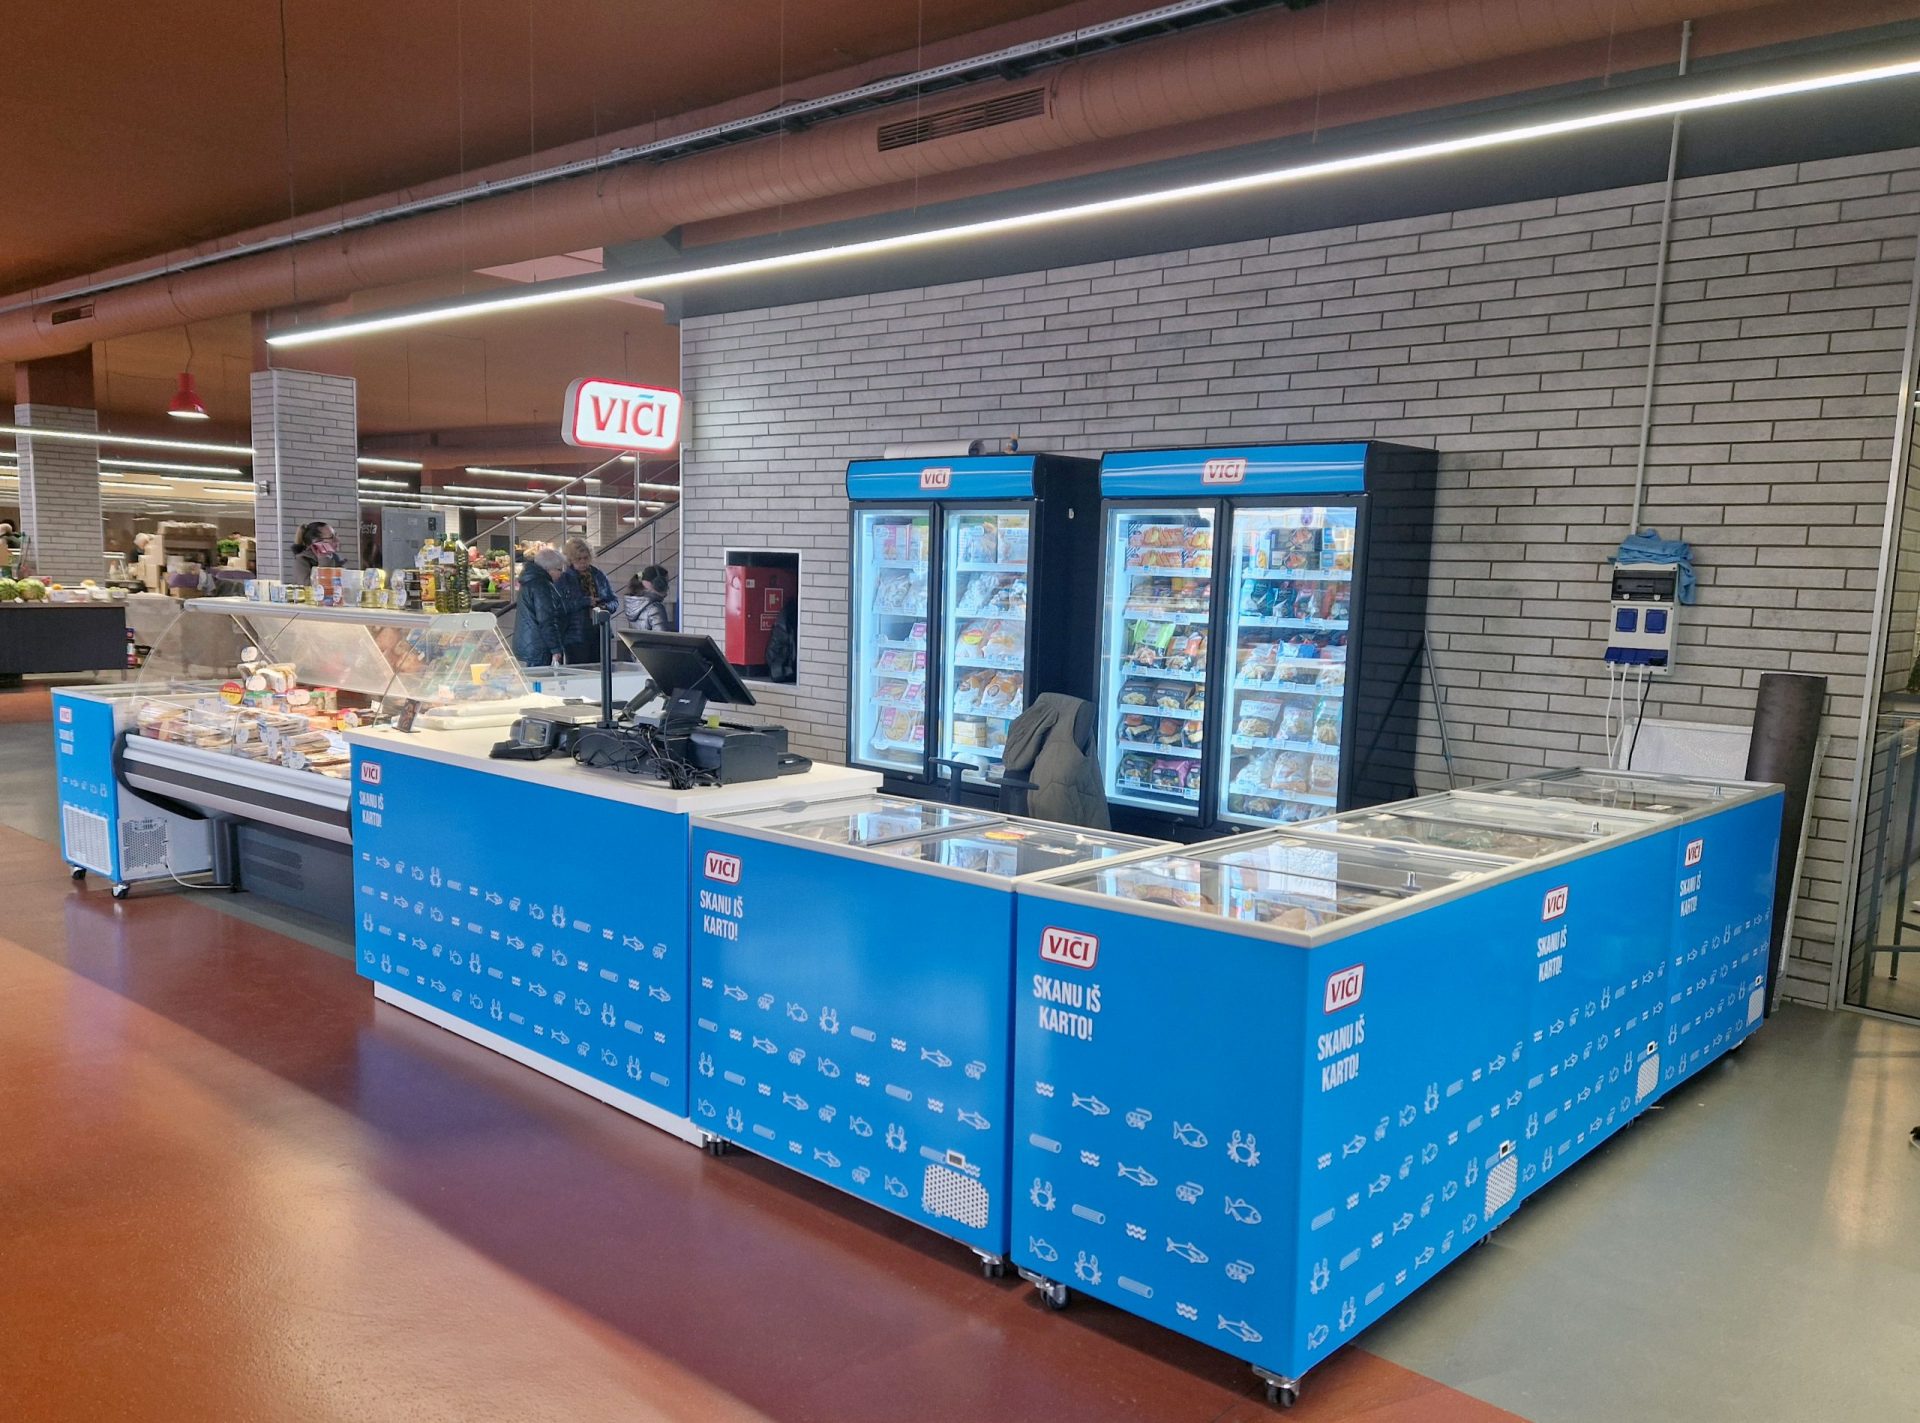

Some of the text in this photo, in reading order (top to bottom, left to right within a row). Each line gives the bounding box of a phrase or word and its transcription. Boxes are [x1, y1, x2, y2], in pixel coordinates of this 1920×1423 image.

[700, 889, 743, 918] SKANU IŠ
[704, 914, 737, 941] KARTO!
[1537, 924, 1568, 958] SKANU IŠ
[1539, 955, 1563, 983] KARTO!
[1033, 974, 1101, 1013] SKANU IŠ
[1040, 1006, 1093, 1041] KARTO!
[1318, 1013, 1365, 1061] SKANU IŠ
[1322, 1052, 1359, 1092] KARTO!
